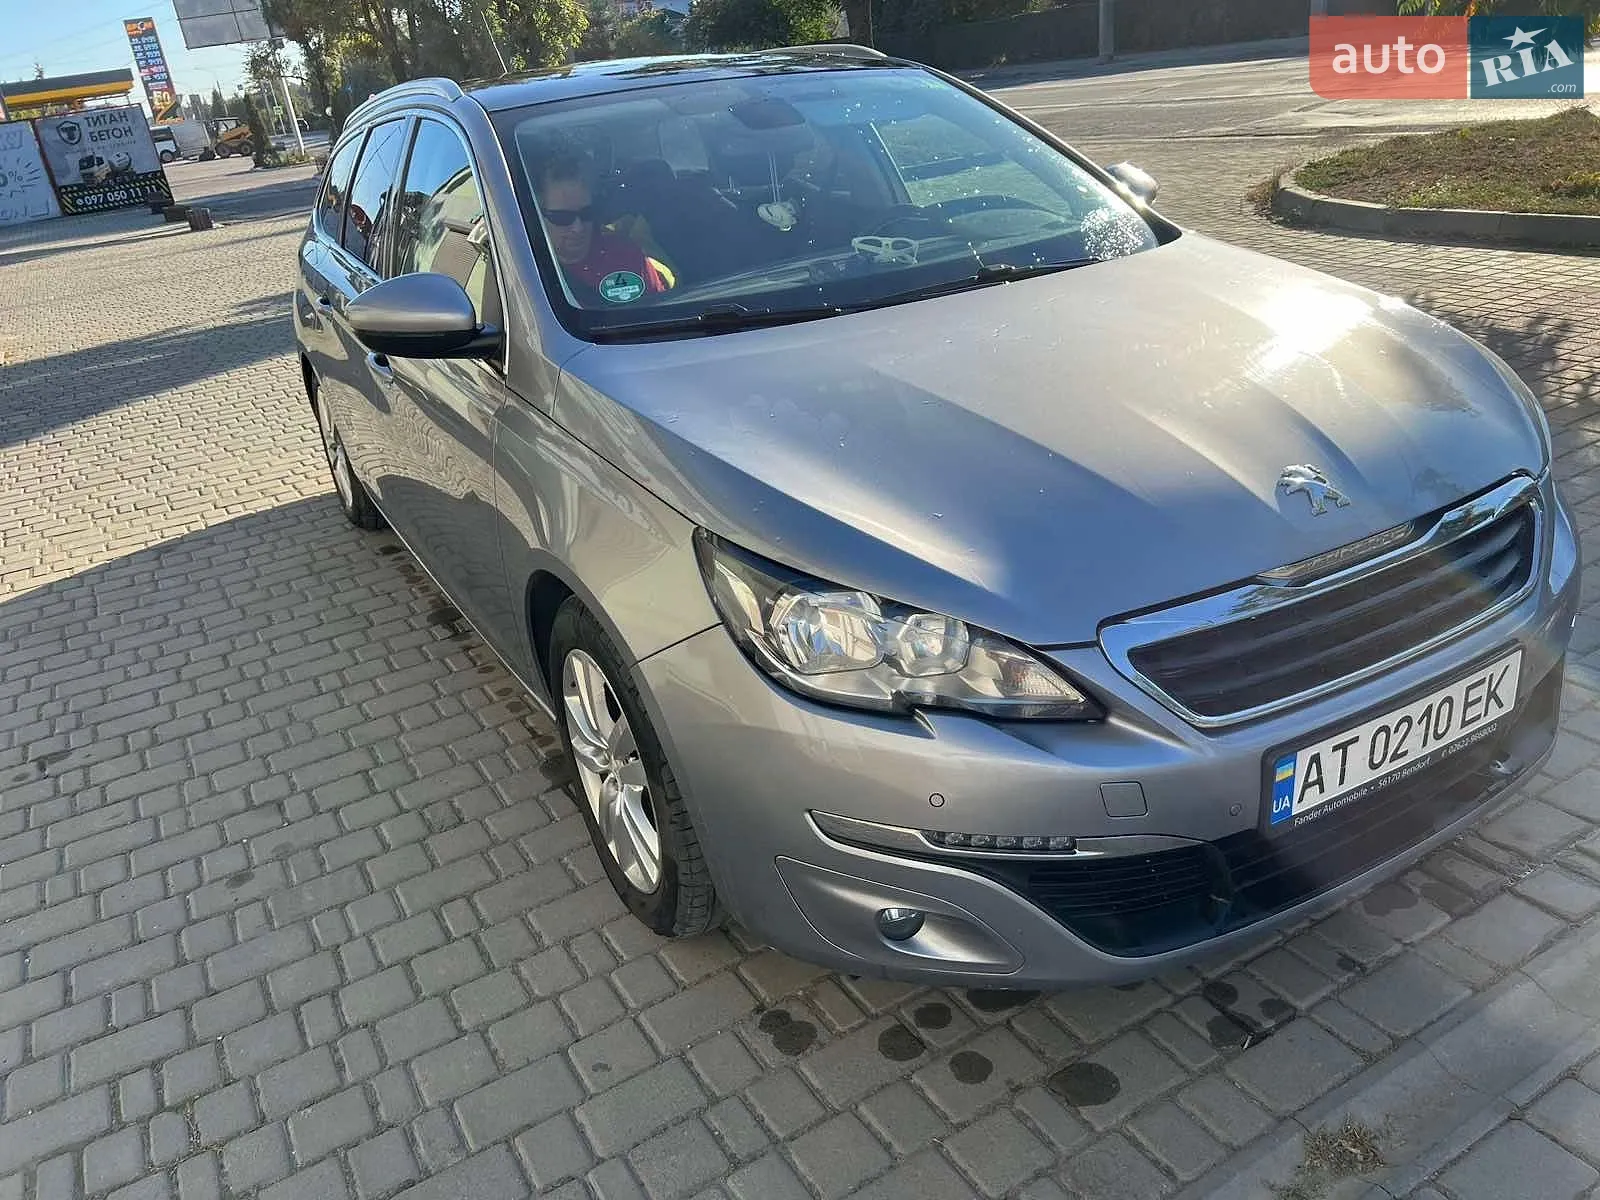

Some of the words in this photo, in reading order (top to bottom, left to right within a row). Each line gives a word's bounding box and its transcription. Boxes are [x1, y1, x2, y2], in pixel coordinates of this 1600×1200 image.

[84, 111, 129, 127] ТИТАН
[88, 126, 134, 142] БЕТОН
[84, 193, 104, 206] 097
[106, 190, 128, 201] 050
[129, 188, 143, 198] 11
[1297, 735, 1360, 804] AT
[1367, 695, 1454, 771] 0210
[1460, 664, 1511, 730] EK
[1273, 795, 1290, 813] UA
[1293, 808, 1321, 827] Fander
[1321, 787, 1368, 816] Automobile
